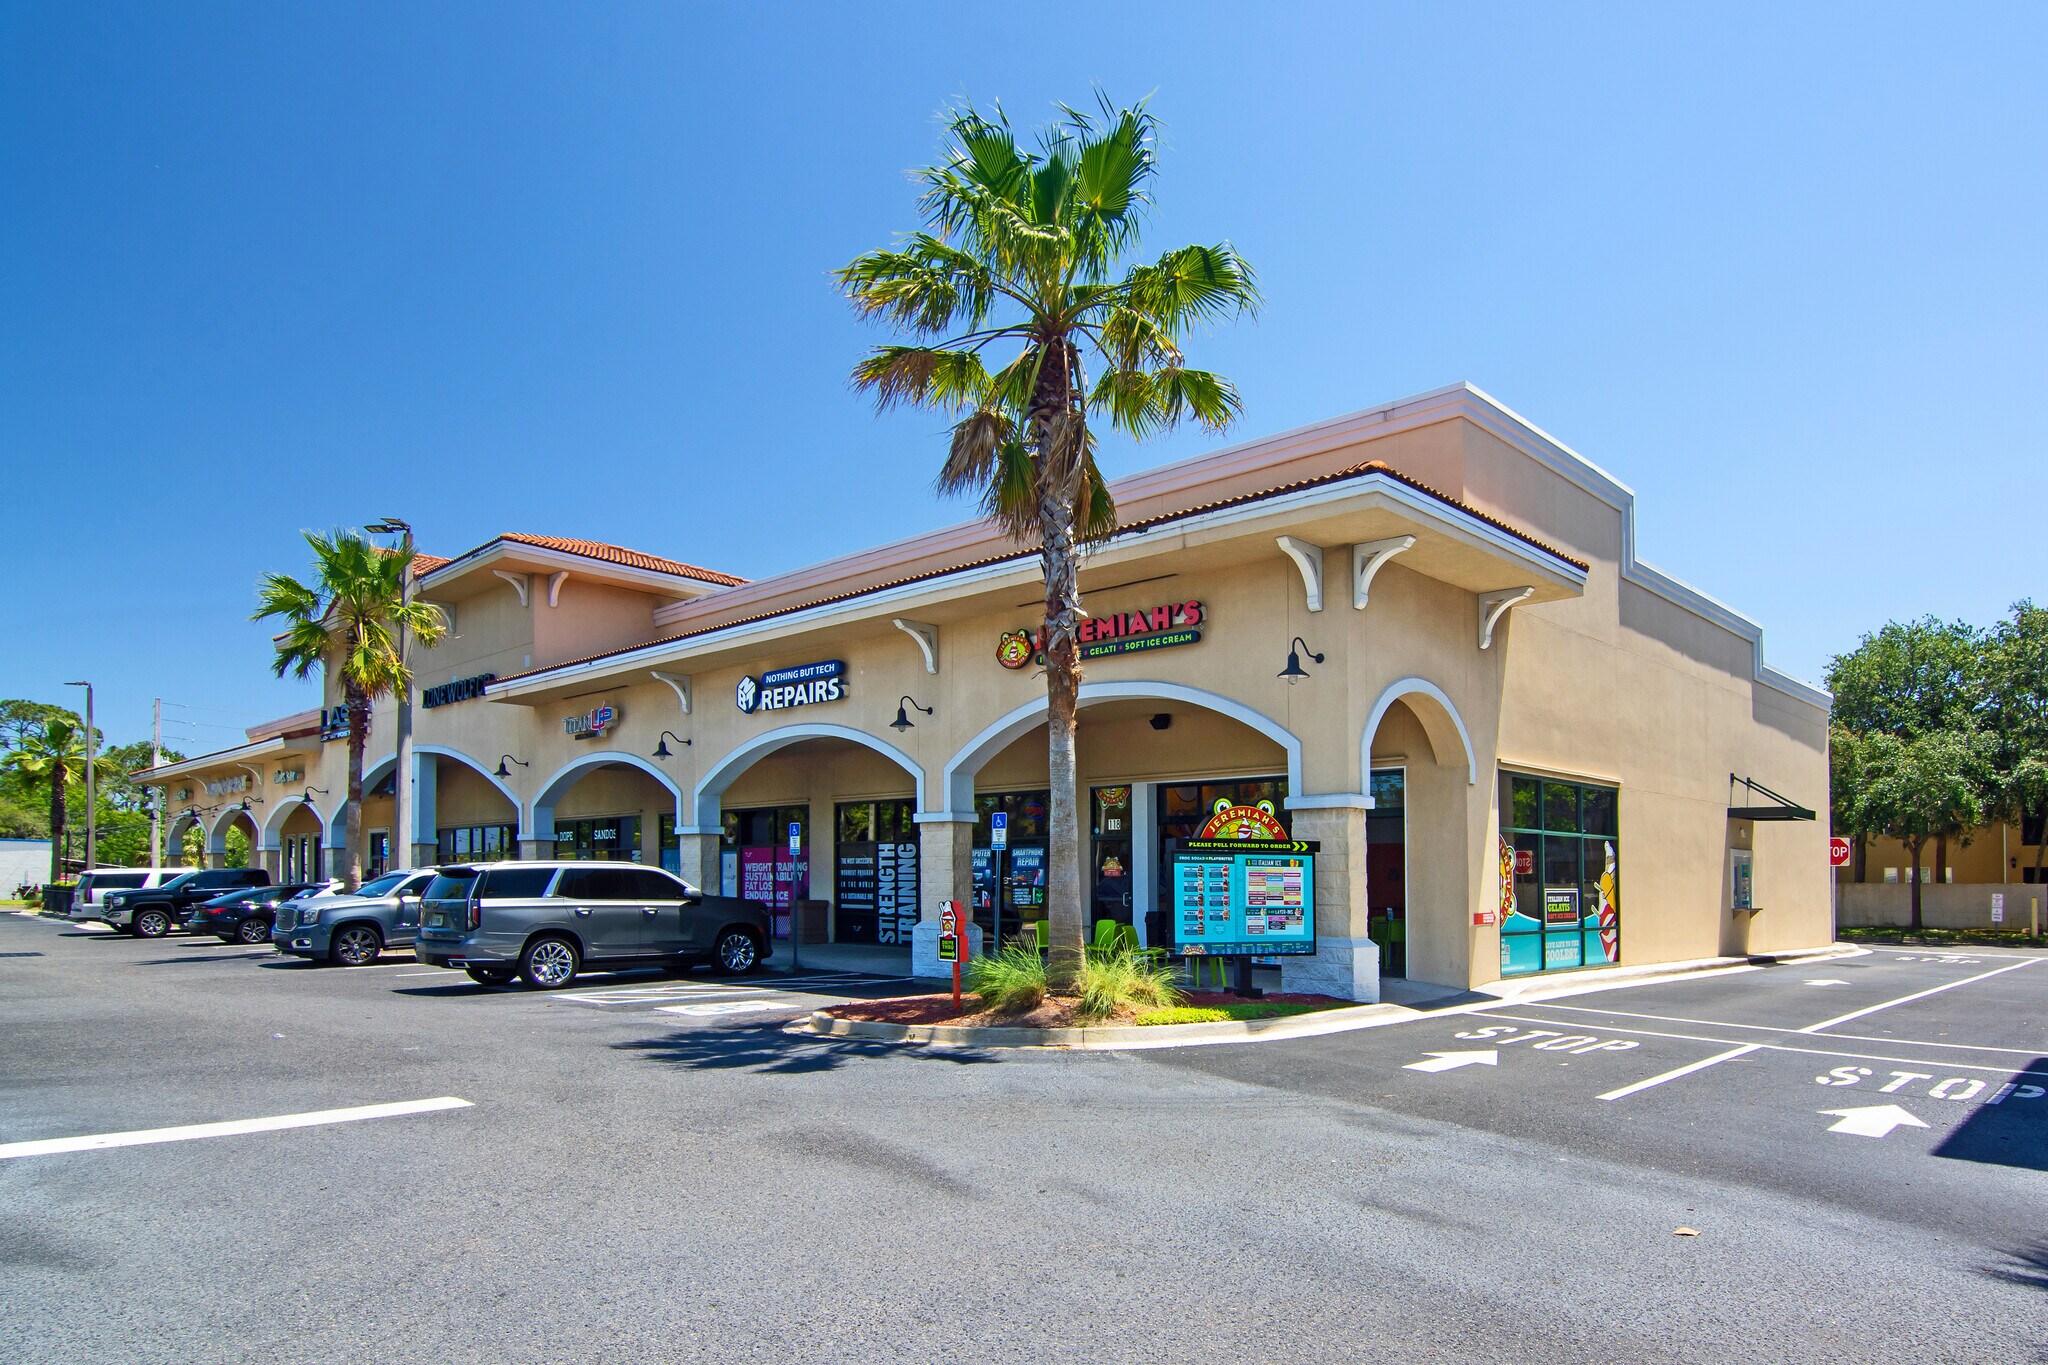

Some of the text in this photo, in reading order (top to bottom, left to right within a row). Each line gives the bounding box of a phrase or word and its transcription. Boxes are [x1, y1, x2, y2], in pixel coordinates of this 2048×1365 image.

[1090, 645, 1116, 656] GELATI
[1125, 641, 1145, 651] SOFT
[1147, 639, 1160, 647] ICE
[1162, 634, 1192, 645] CREAM
[765, 664, 835, 683] NOTHING BUT TECH
[422, 685, 447, 708] LONE
[447, 677, 478, 702] WOLF
[761, 678, 840, 710] REPAIRS
[1209, 808, 1280, 834] JEREMIAH'S
[560, 831, 573, 841] DOPE
[1012, 848, 1044, 856] SMARTPHONE
[1017, 858, 1040, 866] REPAIR
[745, 863, 772, 871] WEIGHT
[972, 859, 987, 867] EPAIR
[745, 882, 758, 890] FAT
[879, 843, 896, 944] STRENGTH
[897, 843, 917, 945] TRAINING
[1548, 903, 1570, 912] GELATIS
[1454, 1026, 1640, 1054] STOP
[1815, 1066, 2046, 1105] STOP
